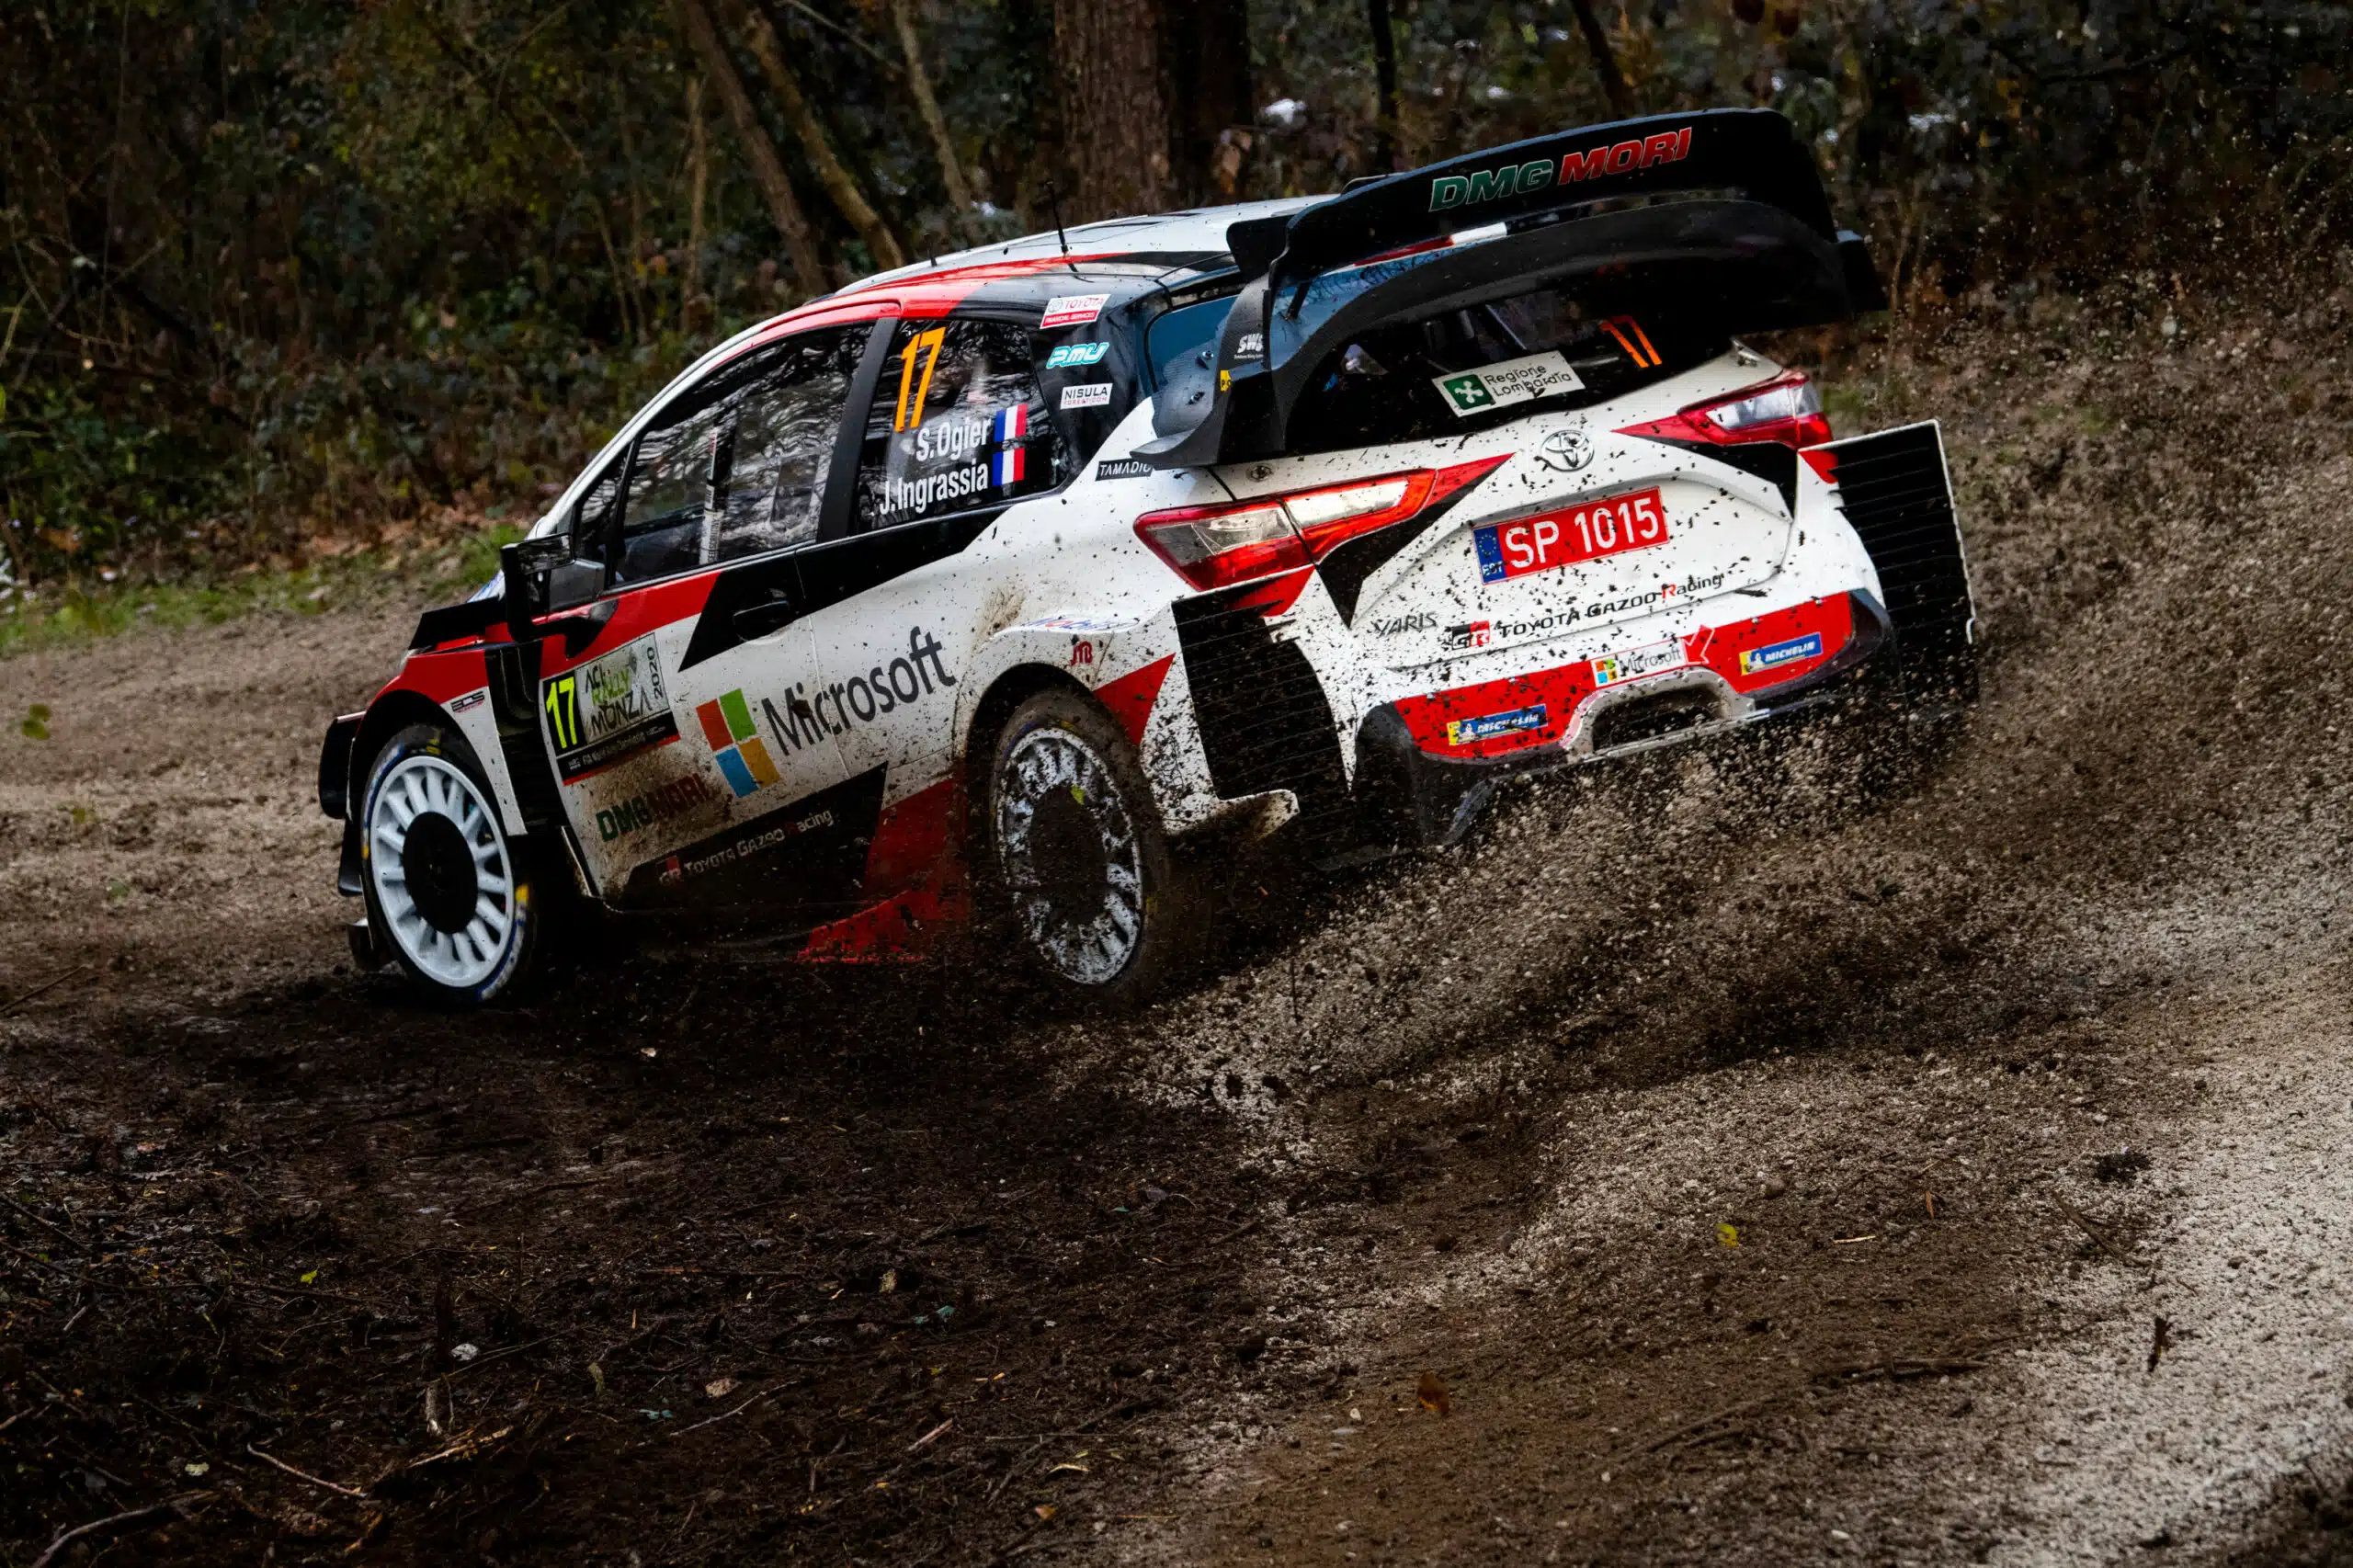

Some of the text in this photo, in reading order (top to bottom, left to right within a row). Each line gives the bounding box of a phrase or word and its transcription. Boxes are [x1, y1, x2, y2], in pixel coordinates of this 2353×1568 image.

[1428, 126, 1692, 212] DMG MORI
[1064, 297, 1104, 309] TOYOTA
[894, 326, 947, 433] 17
[1064, 386, 1108, 400] NISULA
[1484, 365, 1547, 385] Regione
[1492, 371, 1572, 397] Lombardia
[916, 416, 992, 460] S.Ogier
[880, 459, 988, 515] J.Ingrassia
[1505, 497, 1659, 568] SP 1015
[1370, 611, 1438, 637] YARIS
[1499, 608, 1581, 639] TOYOTA
[1586, 591, 1658, 619] GAZOO
[1660, 574, 1723, 599] Racing
[646, 646, 664, 699] 2020
[1620, 645, 1681, 676] Microsoft
[1766, 641, 1816, 662] MICHELIN
[546, 676, 578, 749] 17
[590, 686, 654, 737] MONZA
[761, 626, 956, 756] Microsoft
